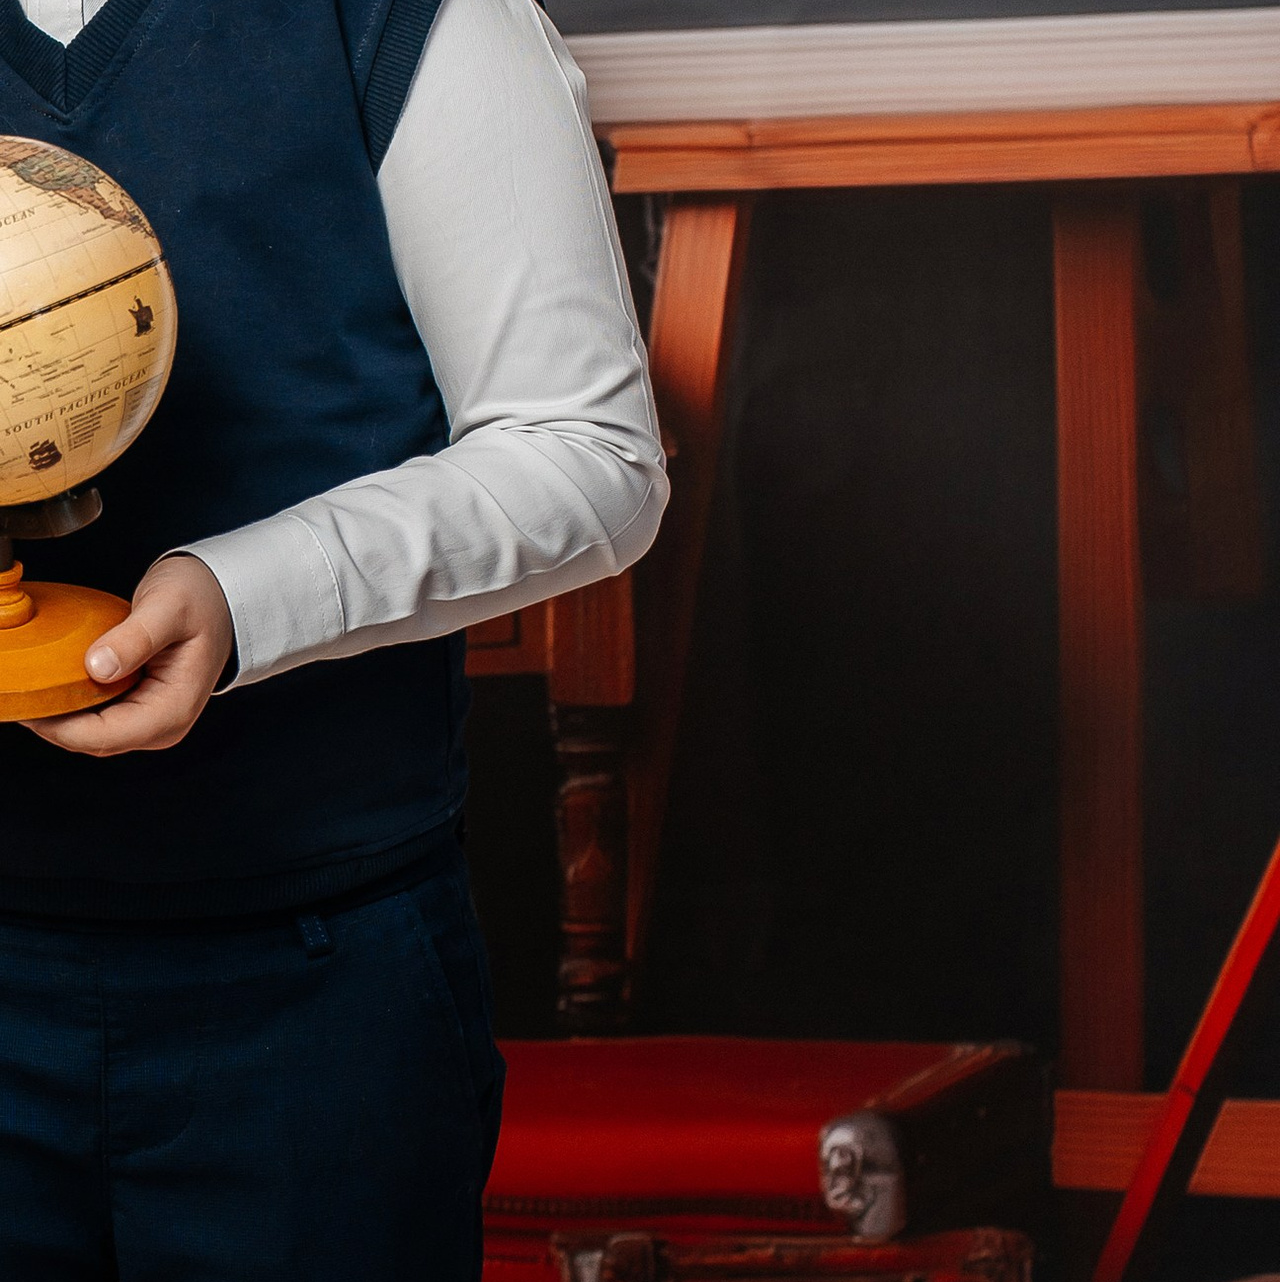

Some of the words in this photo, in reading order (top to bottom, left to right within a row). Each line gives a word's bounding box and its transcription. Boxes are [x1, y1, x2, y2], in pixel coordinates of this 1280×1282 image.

[4, 410, 55, 437] SOUTH
[59, 386, 111, 416] PACIFIC
[114, 367, 149, 391] OCEAN
